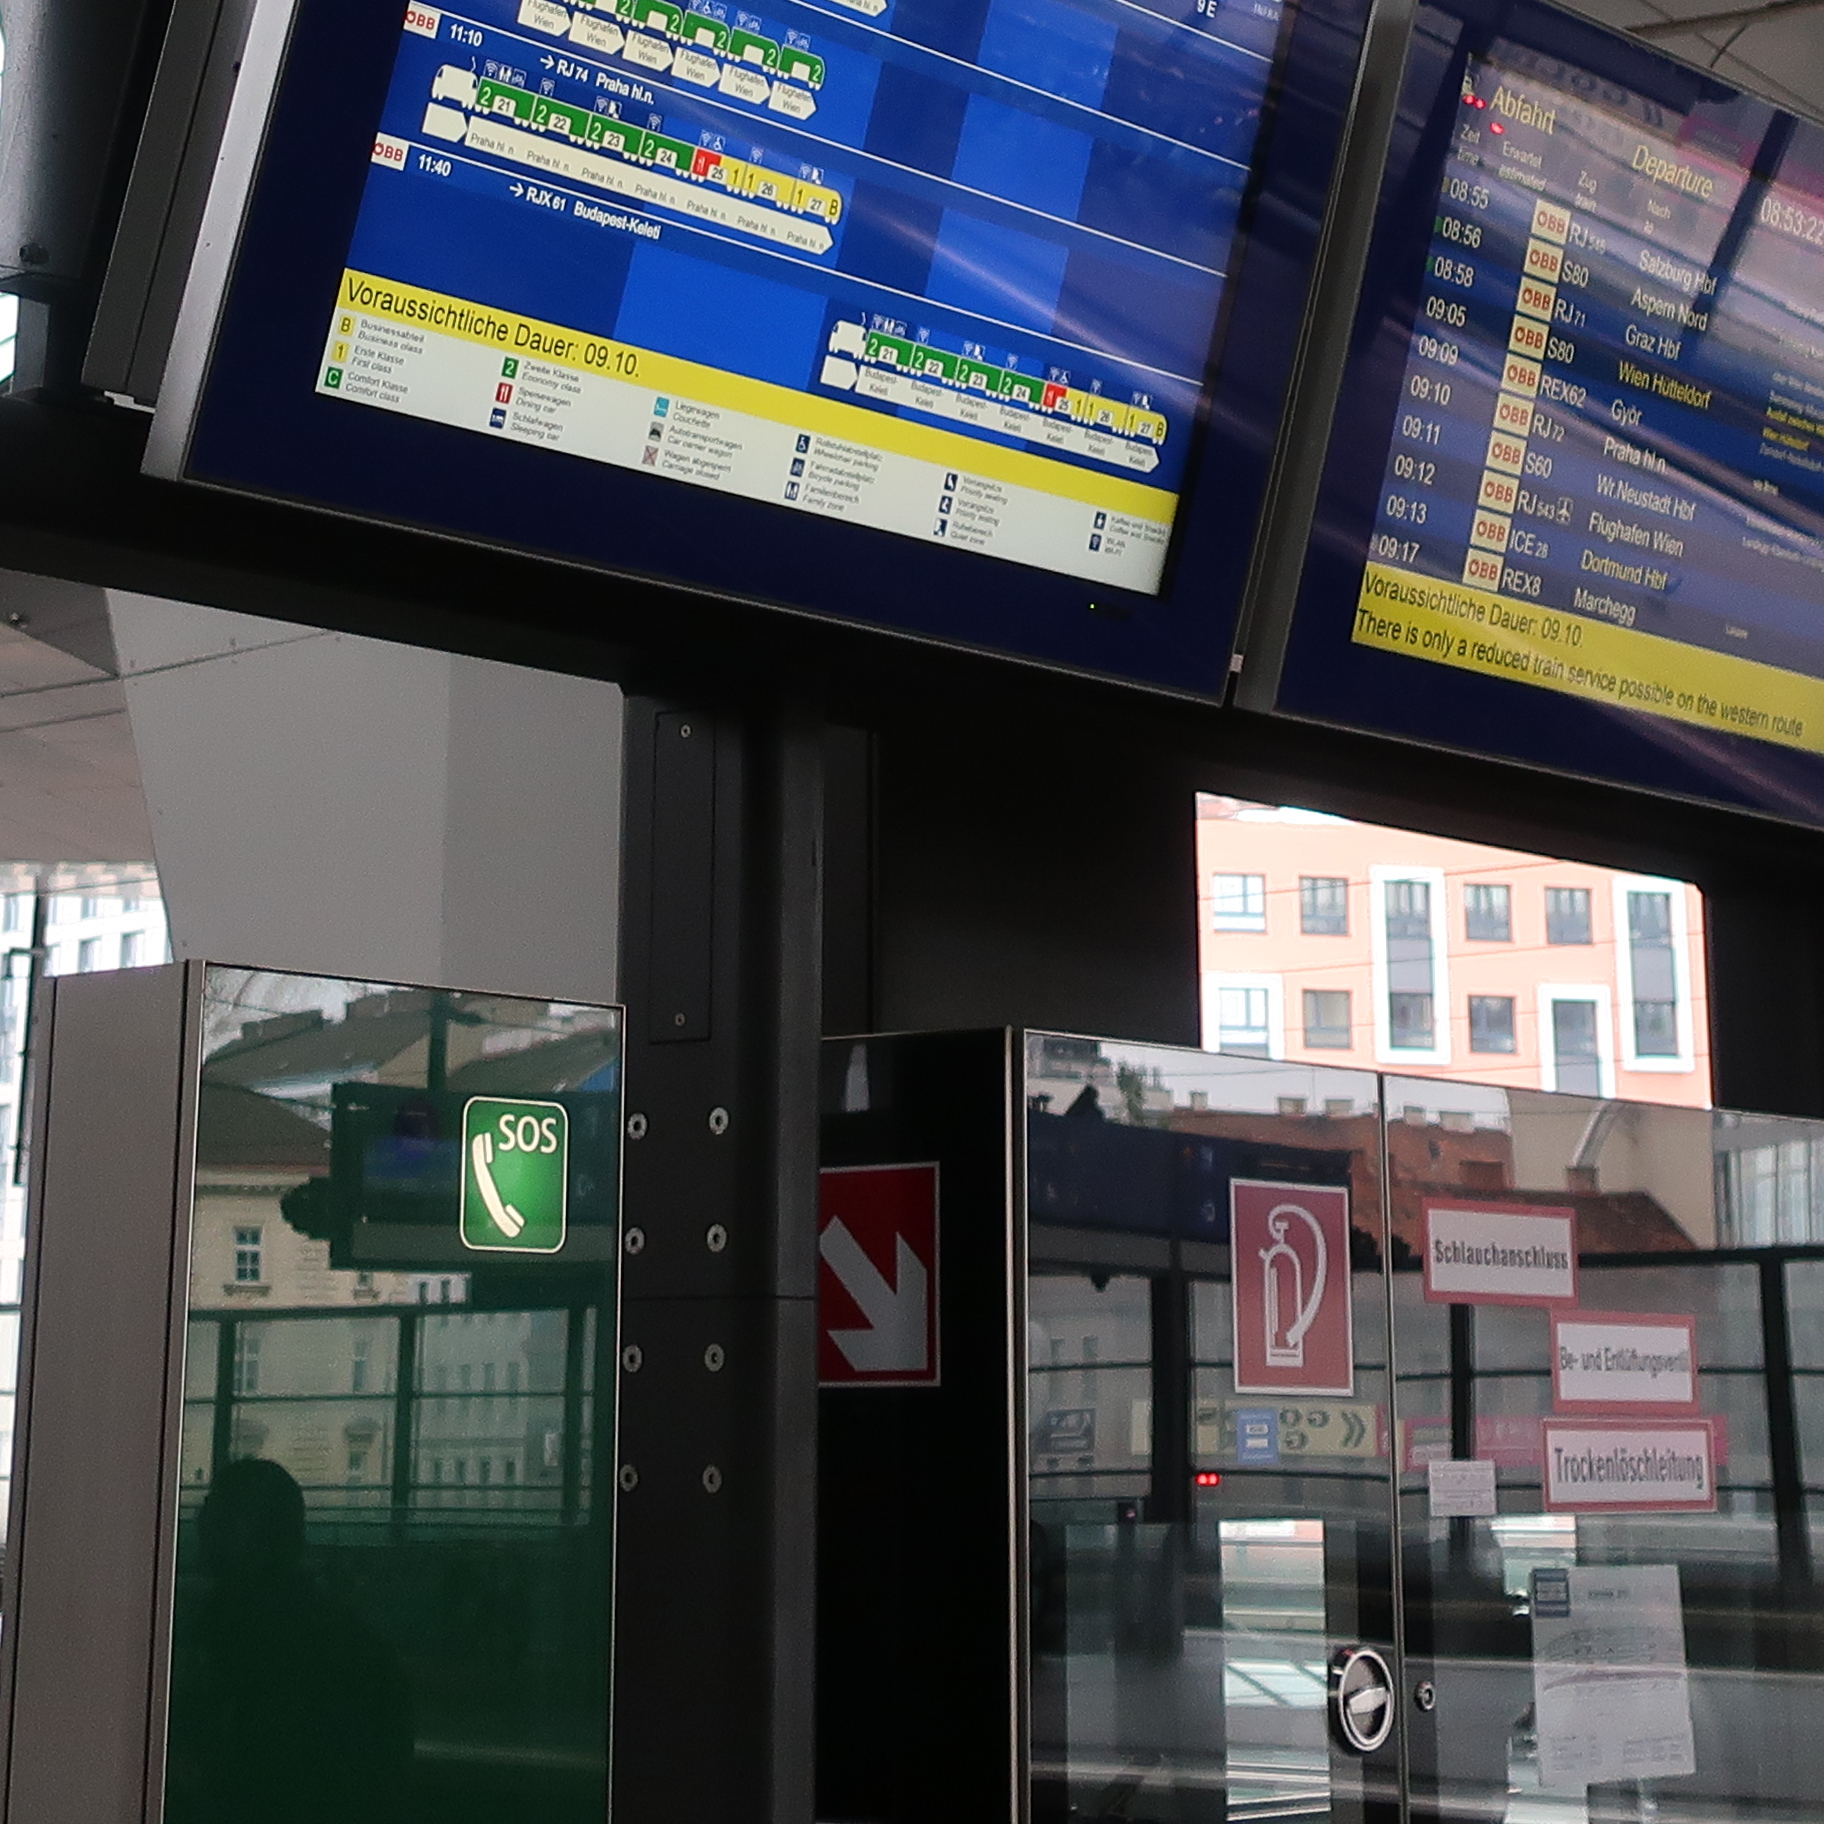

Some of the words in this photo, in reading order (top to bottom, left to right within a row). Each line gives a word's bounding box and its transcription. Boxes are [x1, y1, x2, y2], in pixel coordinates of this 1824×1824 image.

[450, 23, 483, 46] 11:10
[1207, 0, 1217, 18] E
[557, 59, 573, 79] RJ
[573, 64, 588, 83] 74
[595, 72, 629, 97] Praha
[1490, 85, 1556, 135] Abfahrt
[418, 154, 451, 177] 11:40
[1633, 145, 1715, 200] Departure
[527, 186, 553, 209] RJX
[553, 194, 566, 212] 61
[574, 201, 661, 239] Budapest-Keleti
[1449, 177, 1490, 212] 08:55
[1570, 222, 1587, 248] RJ
[1639, 249, 1692, 292] Salzburg
[1694, 271, 1718, 295] Hbf
[1434, 254, 1474, 288] 08:58
[1555, 298, 1574, 323] RJ
[1626, 323, 1656, 354] Graz
[1658, 335, 1683, 361] Hbf
[1442, 215, 1482, 249] 08:56
[1562, 259, 1589, 287] S80
[1630, 286, 1676, 319] Aspern
[1677, 302, 1709, 331] Nord
[347, 277, 509, 342] Voraussichtliche
[513, 322, 578, 362] Dauer:
[583, 341, 641, 379] 09.10.
[1426, 296, 1467, 327] 09:05
[1548, 335, 1575, 364] S80
[1619, 360, 1651, 390] Wien
[1652, 373, 1712, 410] Hütteldorf
[1419, 335, 1459, 366] 09:09
[1540, 375, 1587, 409] REX62
[1411, 375, 1451, 406] 09:10
[1533, 413, 1552, 438] RJ
[1552, 425, 1565, 442] 72
[1604, 436, 1641, 465] Praha
[1394, 454, 1435, 485] 09:12
[1517, 491, 1536, 517] RJ
[1588, 511, 1650, 547] Flughafen
[1653, 530, 1684, 558] Wien
[1402, 415, 1440, 445] 09:11
[1525, 452, 1552, 479] S60
[1673, 497, 1697, 521] Hbf
[1378, 534, 1420, 565] 09:17
[1502, 565, 1542, 598] REX8
[1574, 587, 1636, 627] Marchegg
[1386, 495, 1426, 525] 09:13
[1509, 528, 1533, 556] ICE
[1581, 549, 1643, 584] Dortmund
[1644, 566, 1669, 591] Hbf
[1364, 570, 1485, 623] Voraussichtliche
[1489, 600, 1537, 638] Dauer:
[1541, 615, 1584, 649] 09.10.
[1358, 607, 1402, 640] There
[1404, 617, 1418, 644] is
[1422, 626, 1454, 658] only
[1457, 638, 1469, 656] a
[1470, 636, 1529, 675] reduced
[1532, 651, 1564, 682] train
[1567, 664, 1616, 694] service
[1618, 675, 1675, 709] possible
[1677, 691, 1694, 710] on
[1697, 693, 1717, 718] the
[1720, 701, 1770, 728] western
[1771, 715, 1803, 737] route
[498, 1113, 558, 1154] SOS
[1434, 1240, 1569, 1270] Schlauchanschluss
[1582, 1348, 1602, 1371] und
[1554, 1447, 1704, 1491] Trockenlöschleitung
